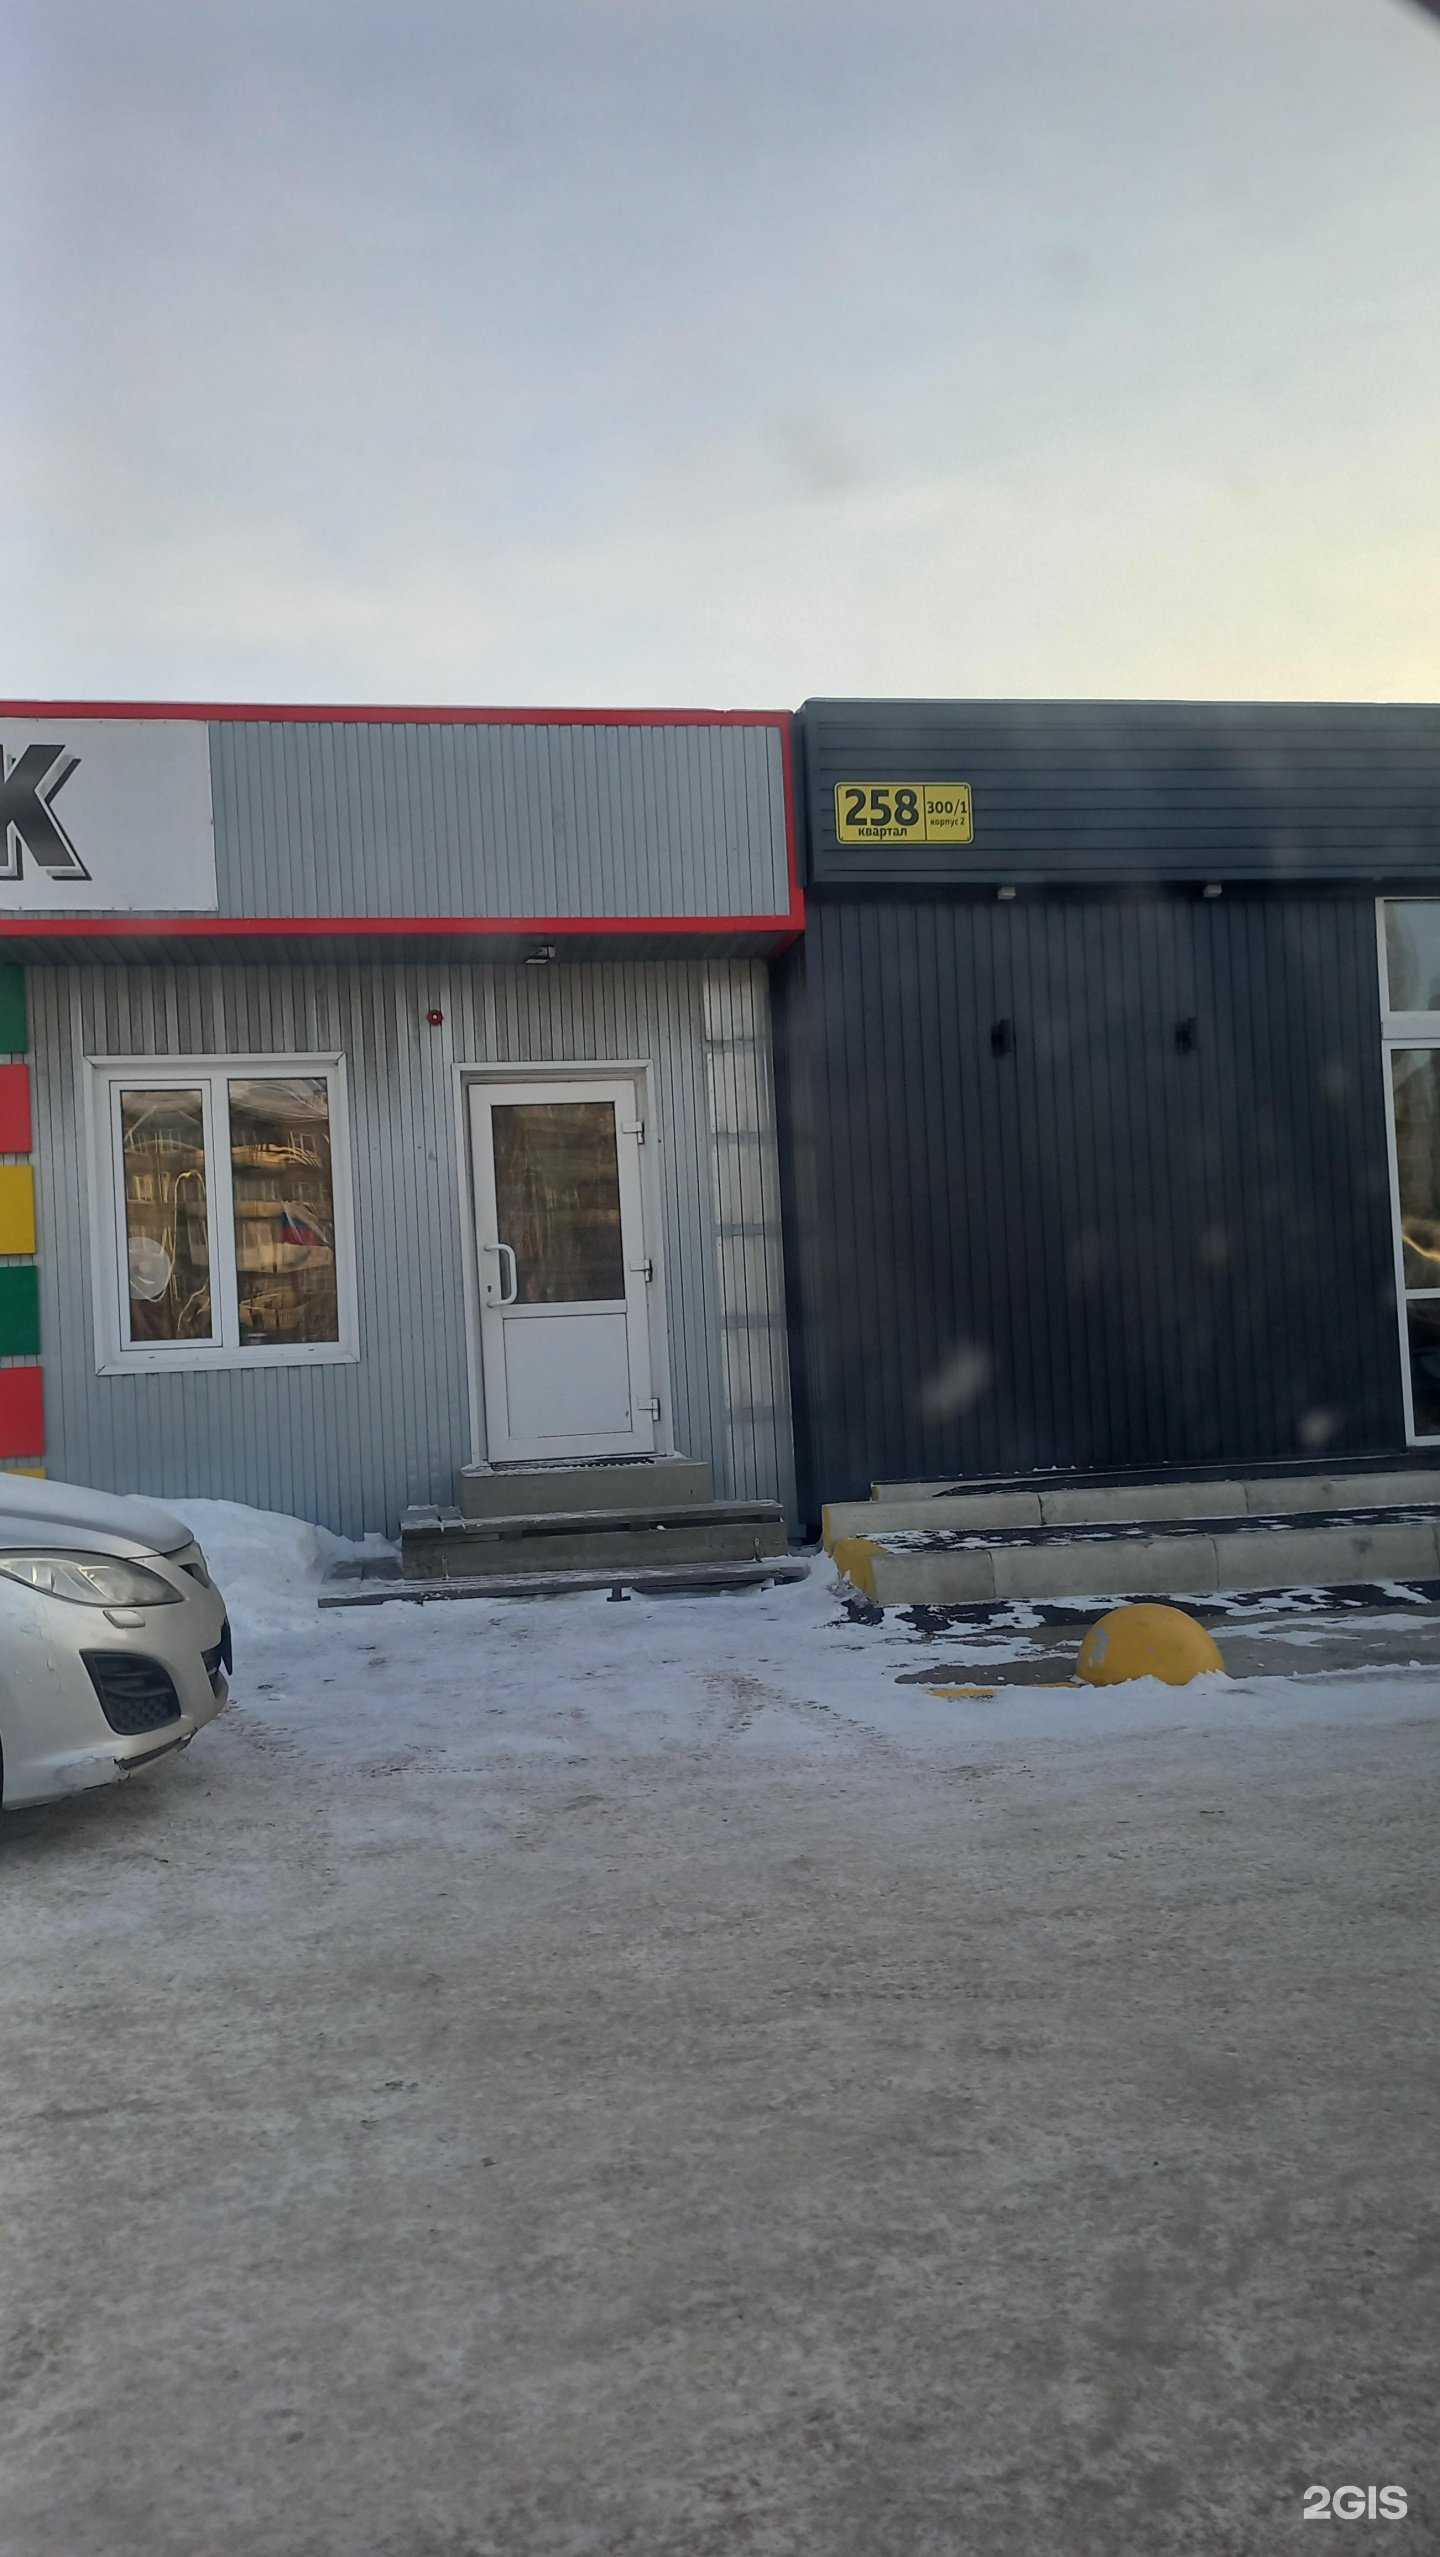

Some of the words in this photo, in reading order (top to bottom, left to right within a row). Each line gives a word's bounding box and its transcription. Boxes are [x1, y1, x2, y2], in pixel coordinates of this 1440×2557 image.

[845, 788, 919, 826] 258
[927, 799, 968, 816] 300/1
[930, 818, 959, 828] корпус
[960, 817, 965, 826] 2
[858, 827, 908, 840] квартал
